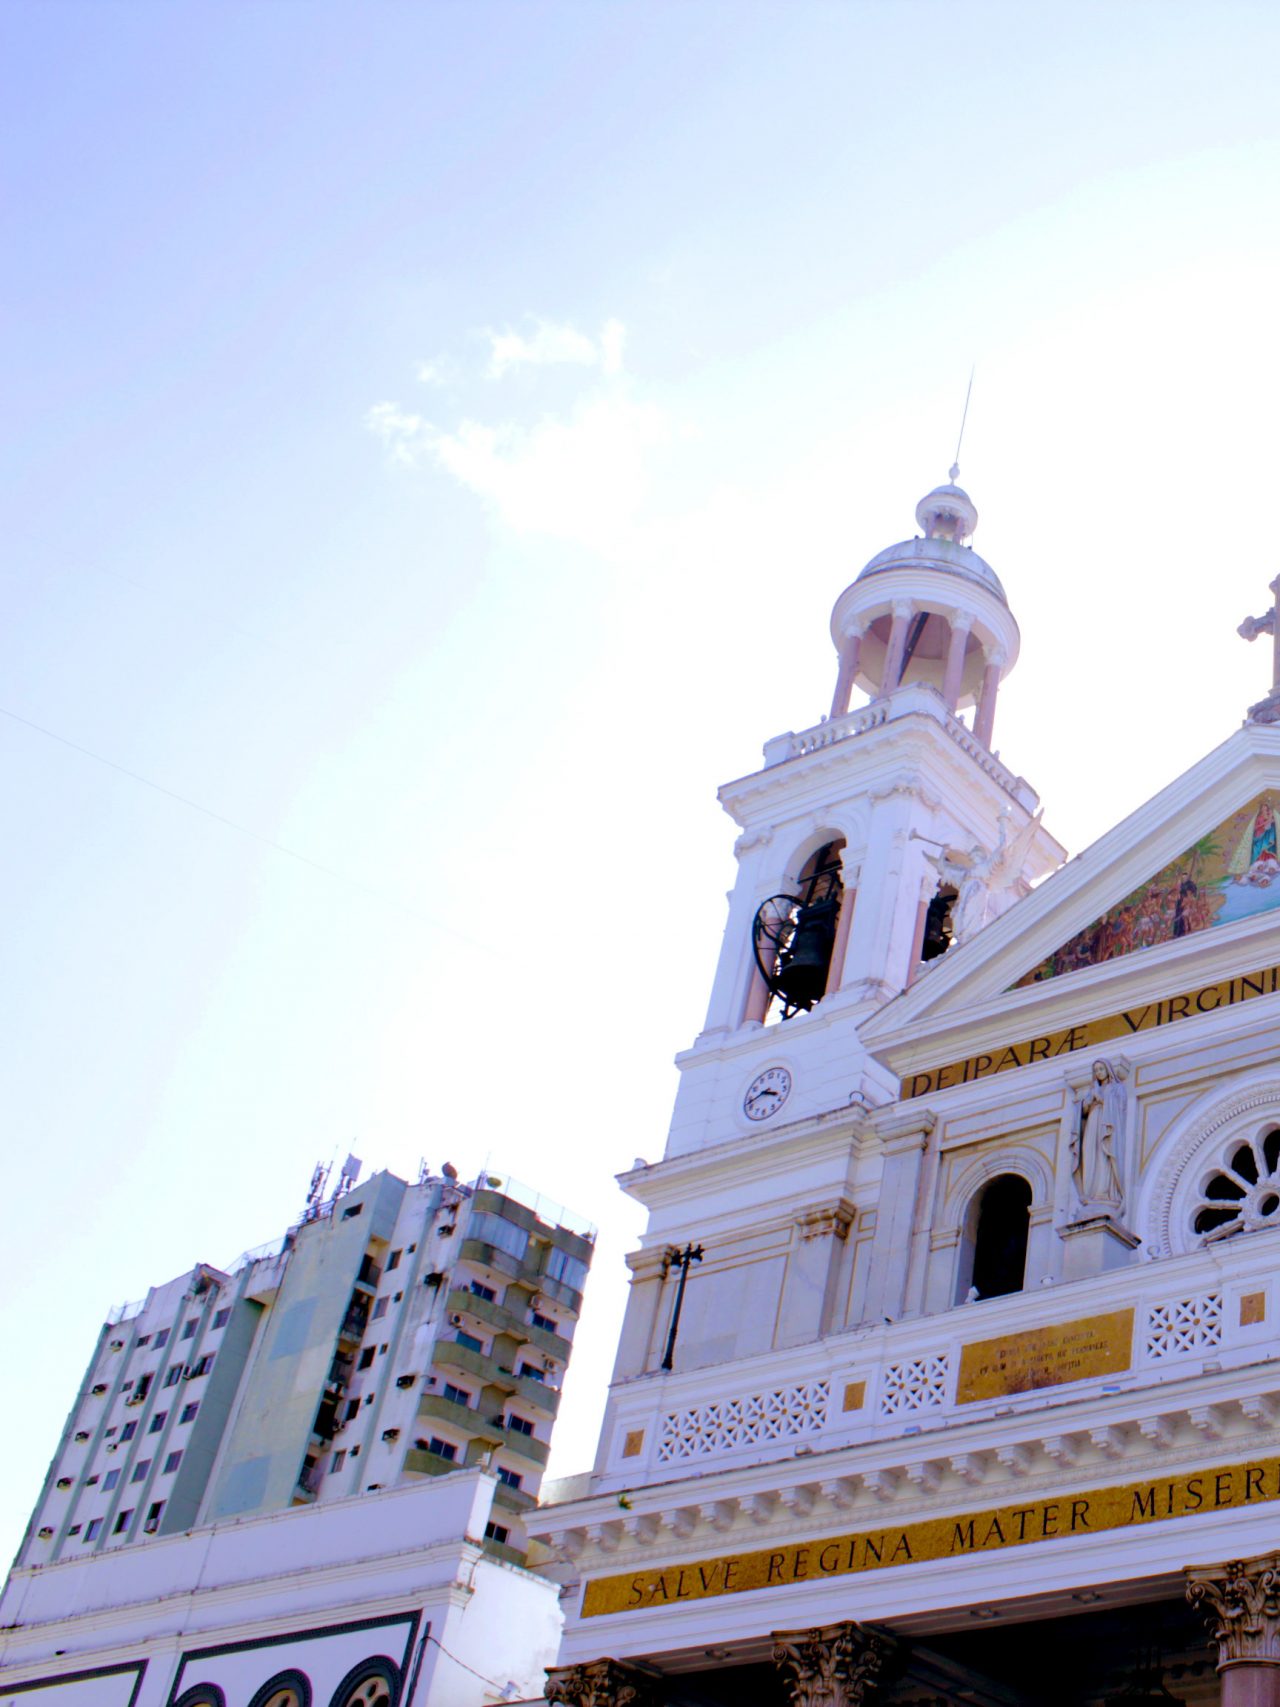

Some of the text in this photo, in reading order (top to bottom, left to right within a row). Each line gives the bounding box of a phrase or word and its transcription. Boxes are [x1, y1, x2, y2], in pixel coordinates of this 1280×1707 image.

[911, 1024, 1088, 1098] DEIPARÆ
[1122, 969, 1279, 1033] VIRGINI
[628, 1561, 740, 1605] SALVE
[766, 1533, 913, 1583] REGINA
[950, 1499, 1091, 1552] MATER
